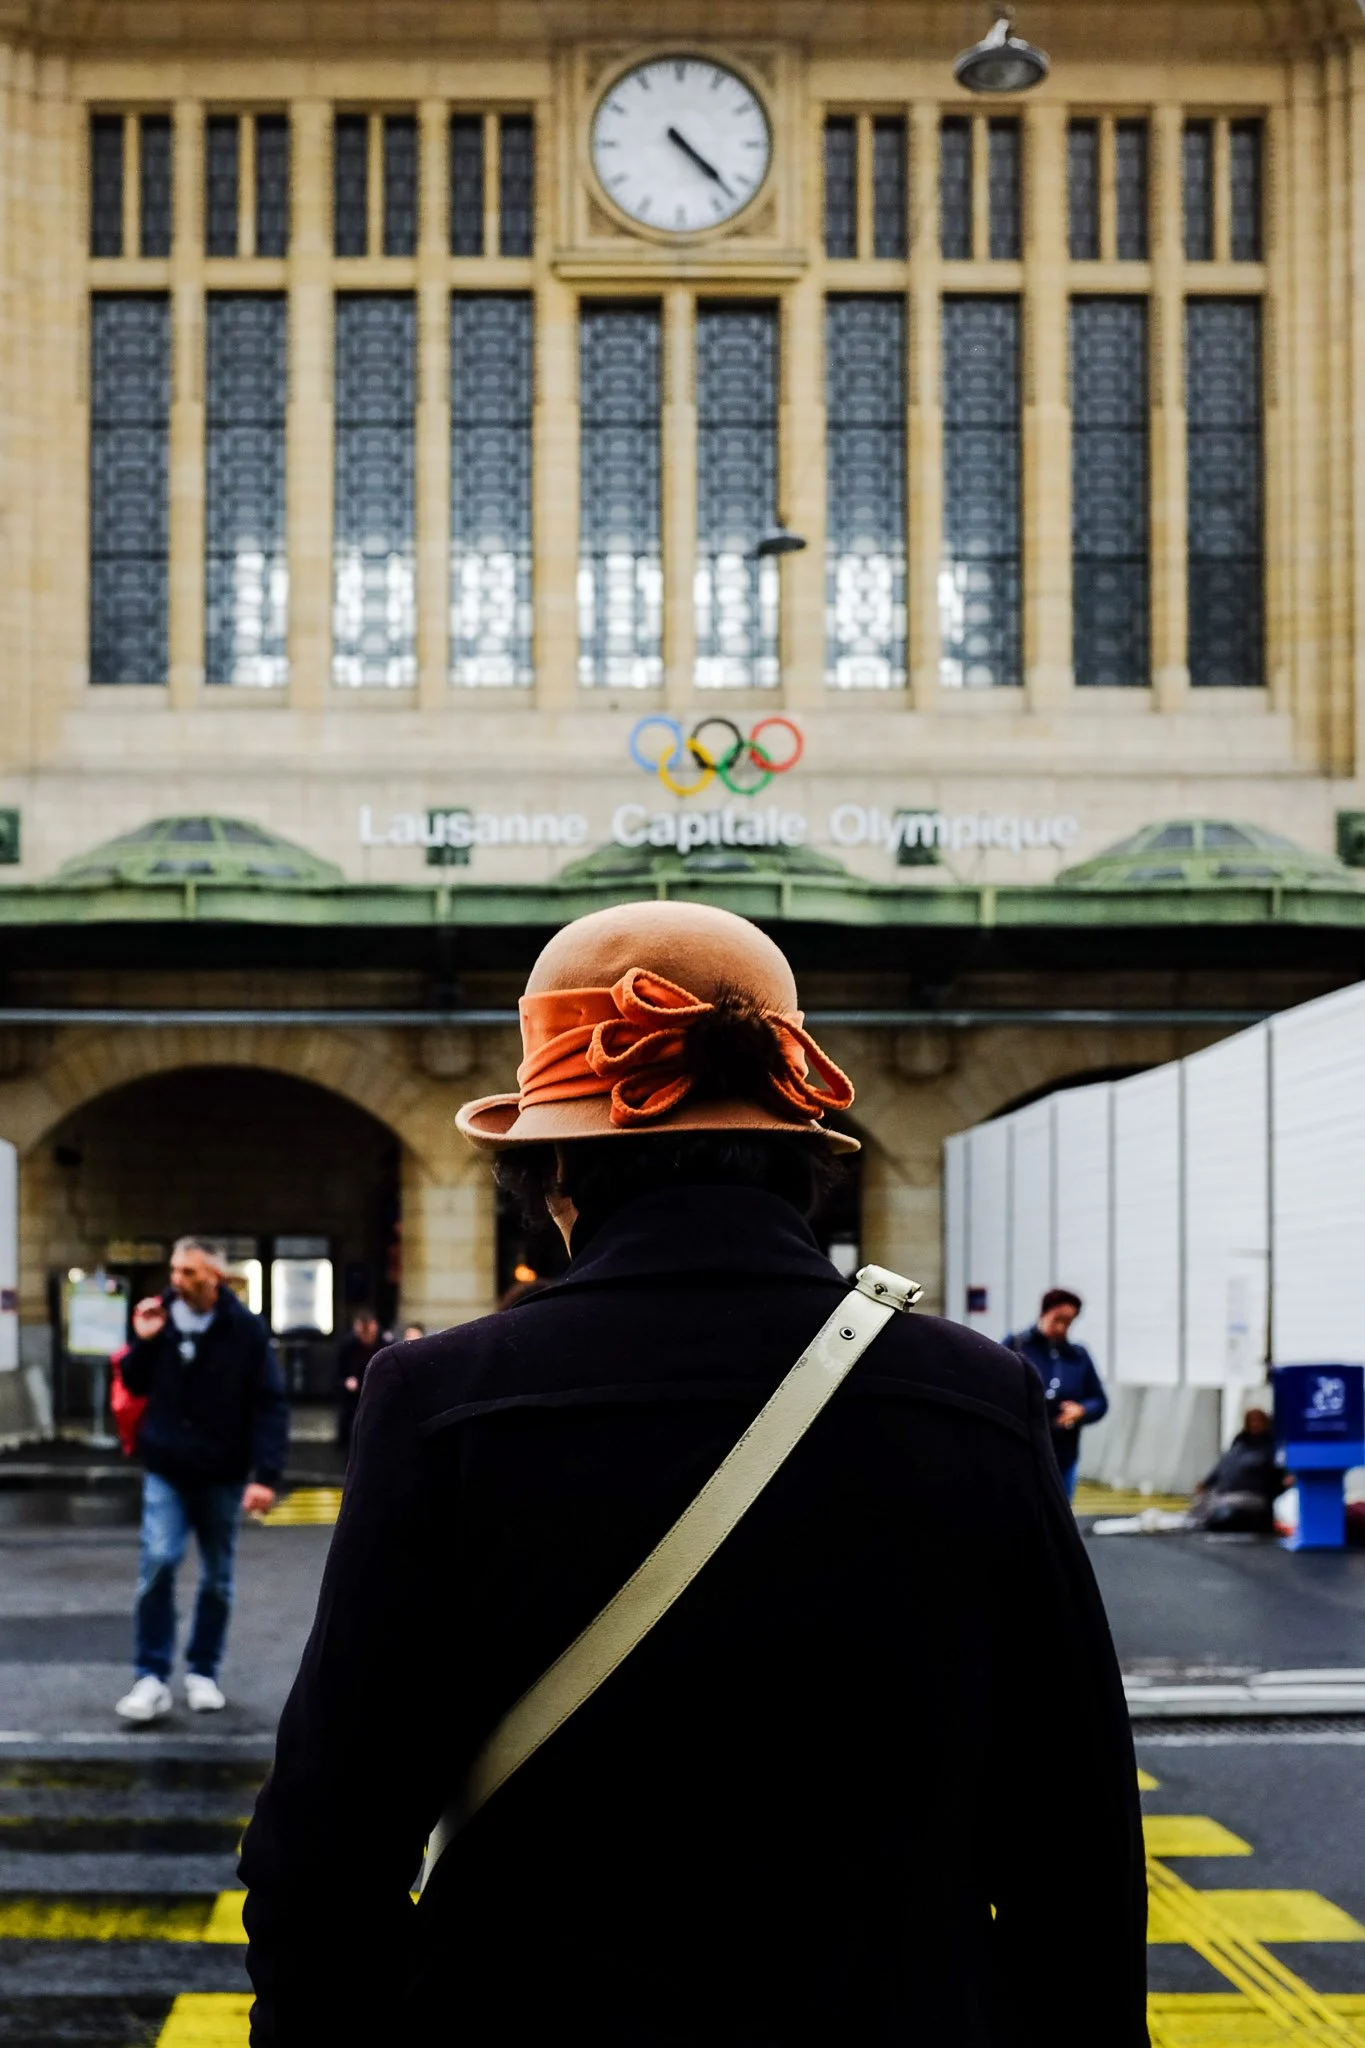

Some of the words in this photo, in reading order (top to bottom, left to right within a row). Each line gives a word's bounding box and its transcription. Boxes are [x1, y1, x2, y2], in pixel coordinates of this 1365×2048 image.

[359, 804, 589, 847] Lausanne
[611, 803, 807, 854] Capitale
[829, 804, 1080, 853] Olympique
